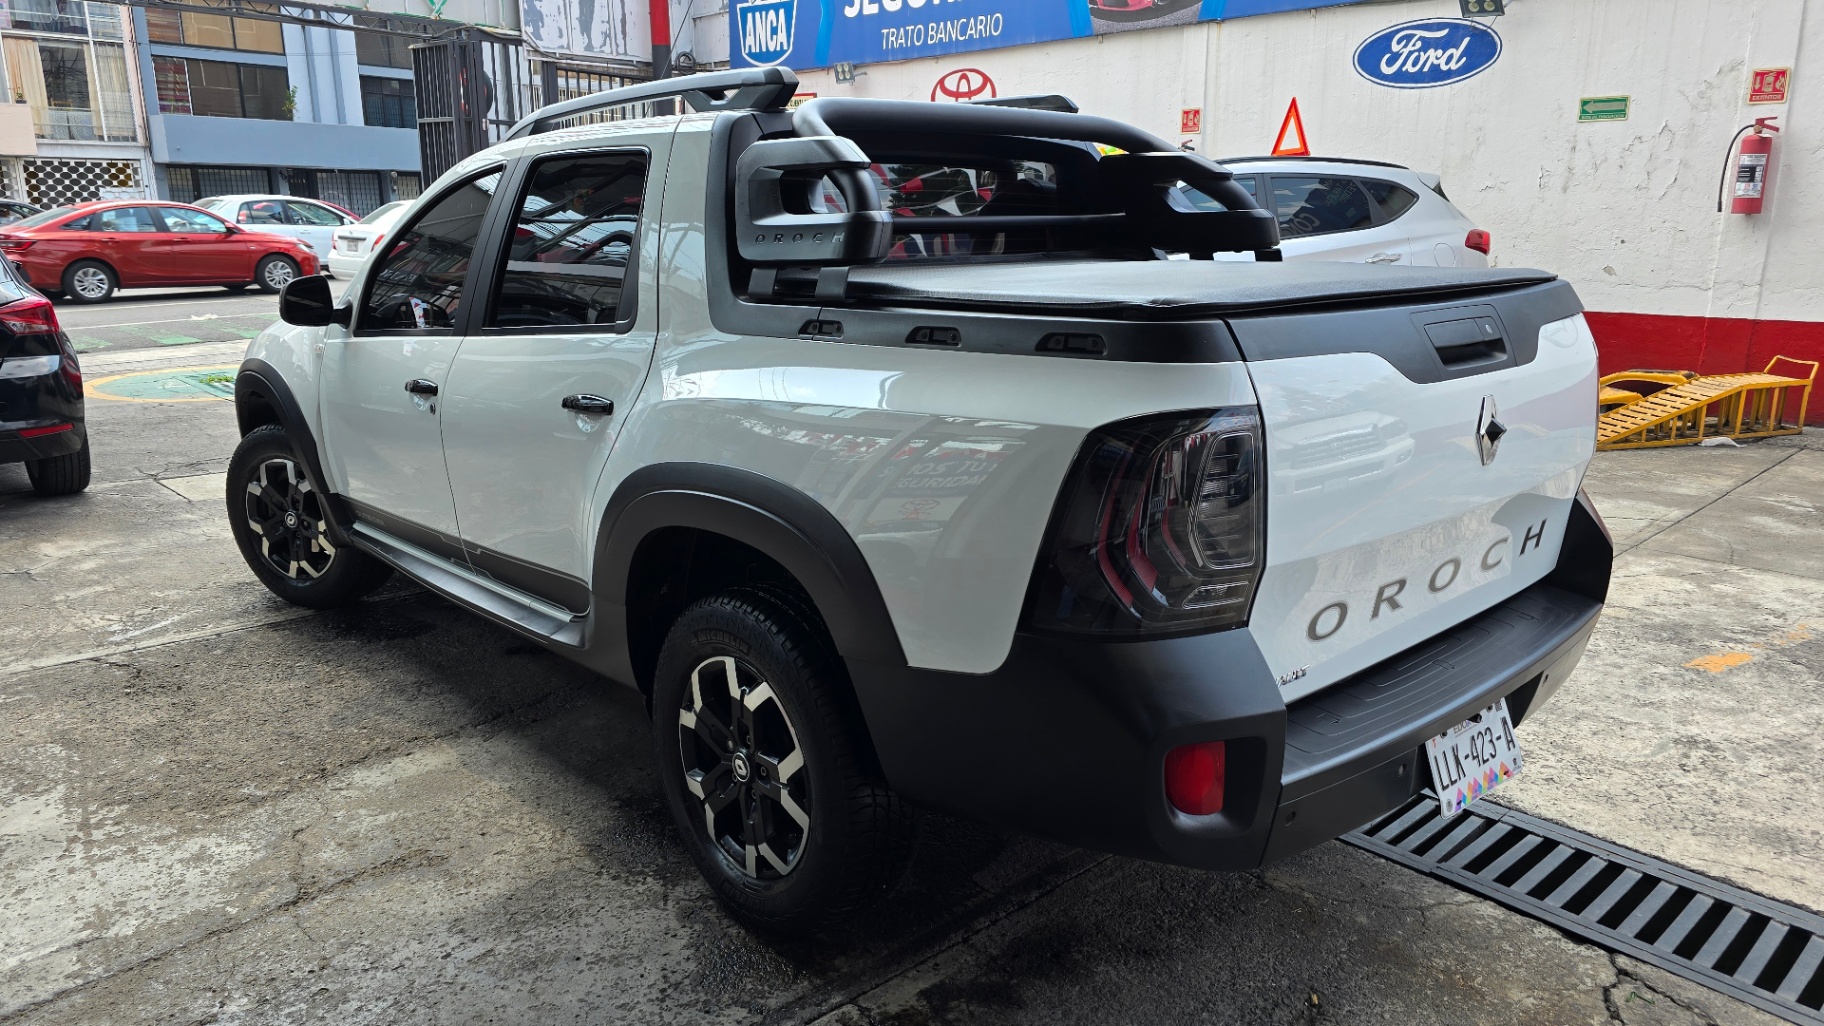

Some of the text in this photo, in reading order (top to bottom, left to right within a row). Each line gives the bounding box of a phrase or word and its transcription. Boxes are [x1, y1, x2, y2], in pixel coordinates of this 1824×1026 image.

[745, 8, 788, 53] ANCA
[881, 13, 1003, 50] TRATO BANCARIO
[1380, 28, 1471, 74] Ford
[755, 232, 846, 244] OROCH
[1305, 517, 1548, 643] OROCH
[1434, 716, 1516, 791] LLK-423-A
